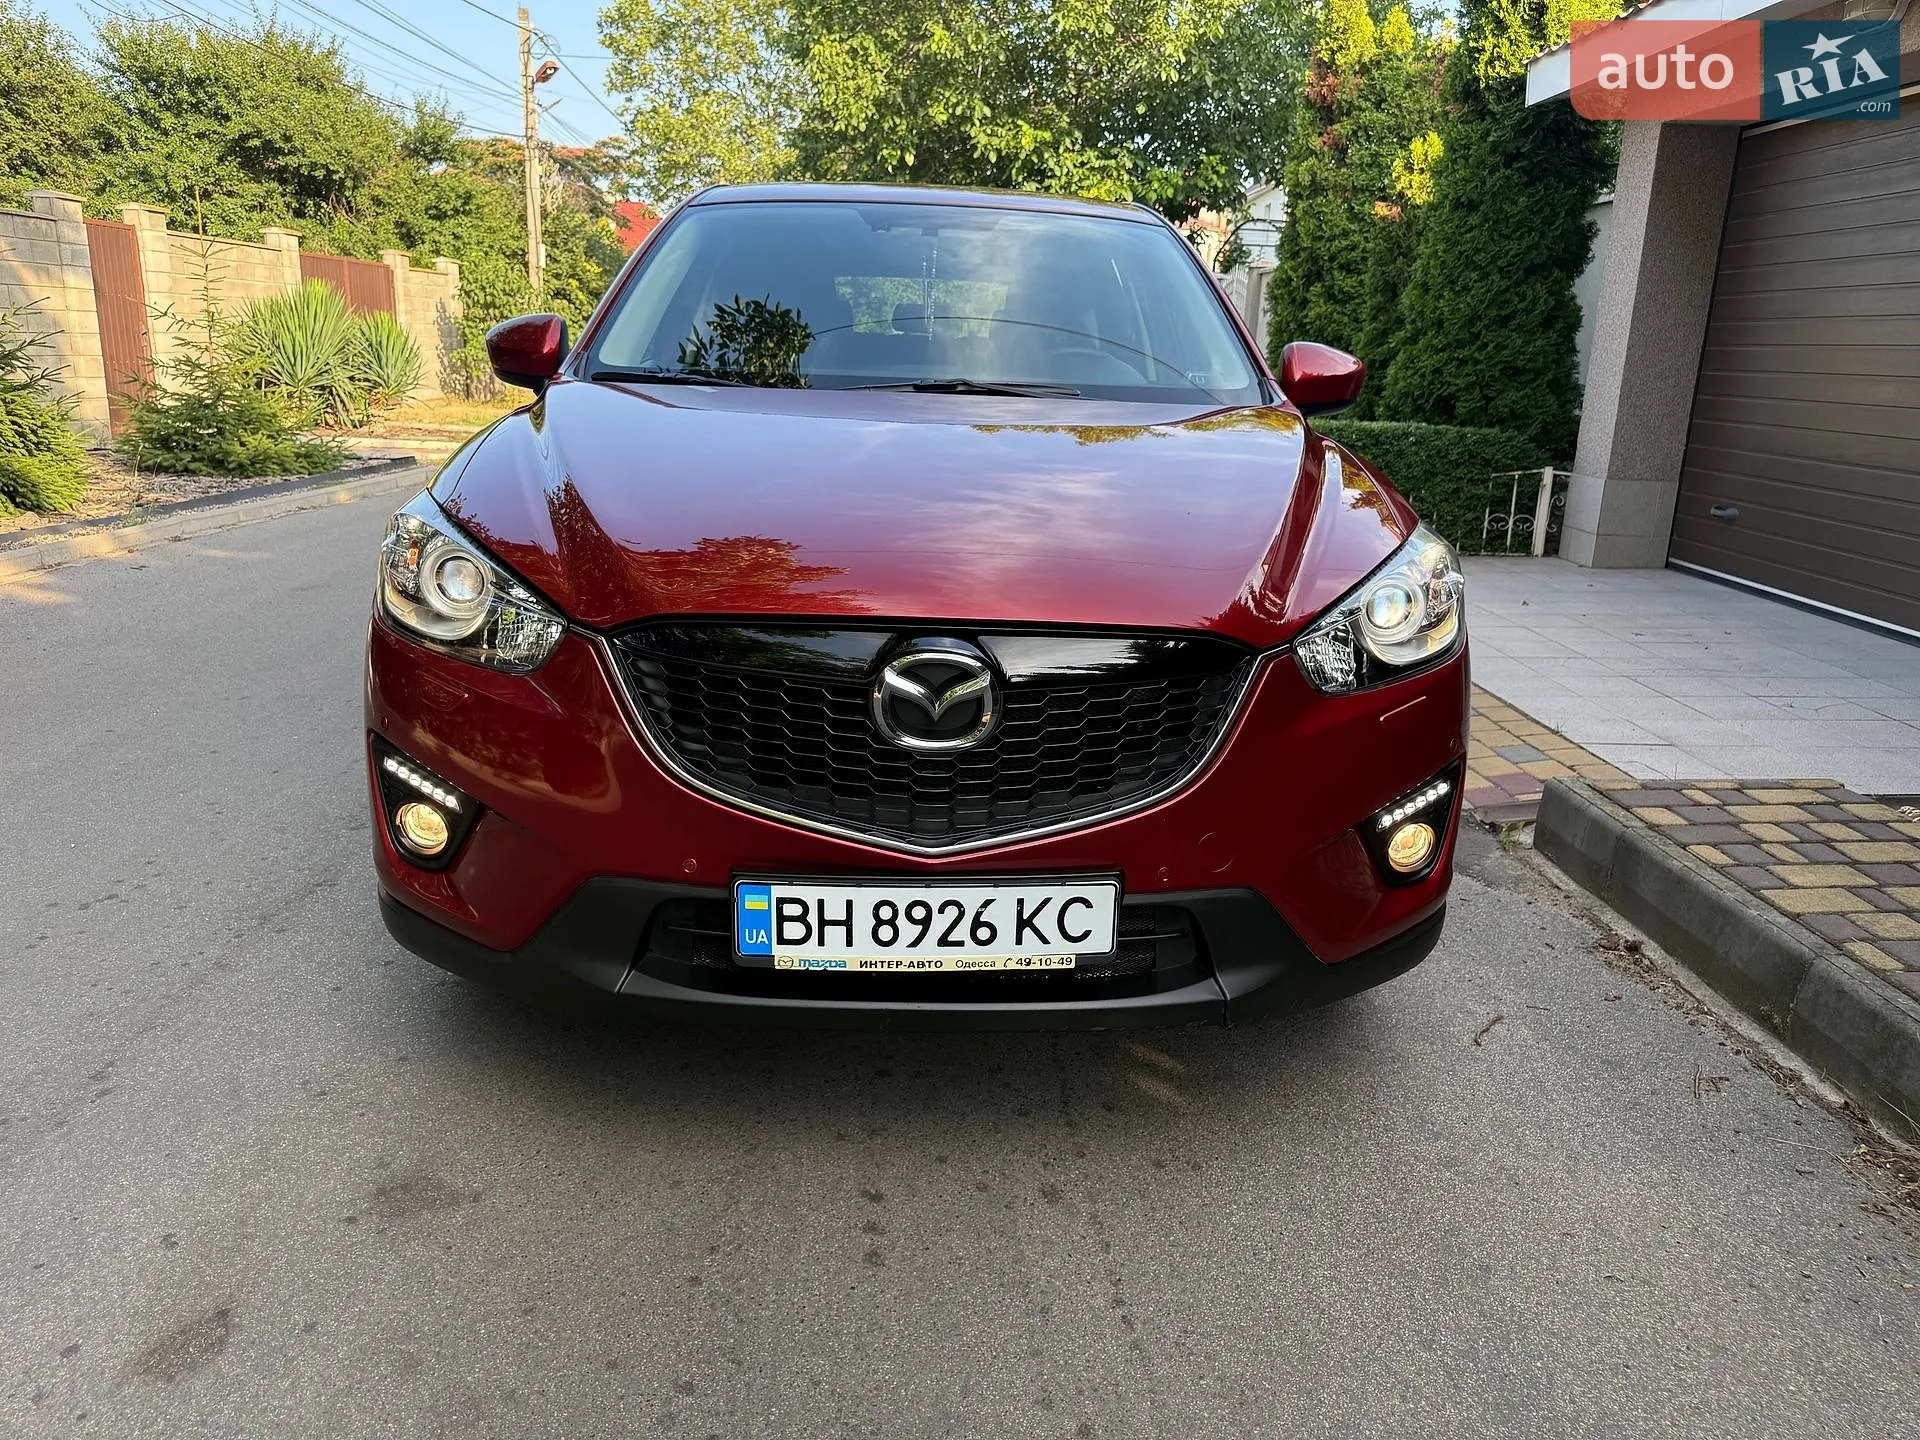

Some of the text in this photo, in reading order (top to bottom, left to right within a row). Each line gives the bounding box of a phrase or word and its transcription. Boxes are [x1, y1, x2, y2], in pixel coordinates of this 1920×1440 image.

[776, 896, 1094, 948] BH 8926 KC
[745, 928, 769, 944] UA
[859, 960, 943, 969] ИНТЕР-АВТО
[955, 959, 996, 969] Одесса
[1015, 956, 1073, 968] 49-10-49
